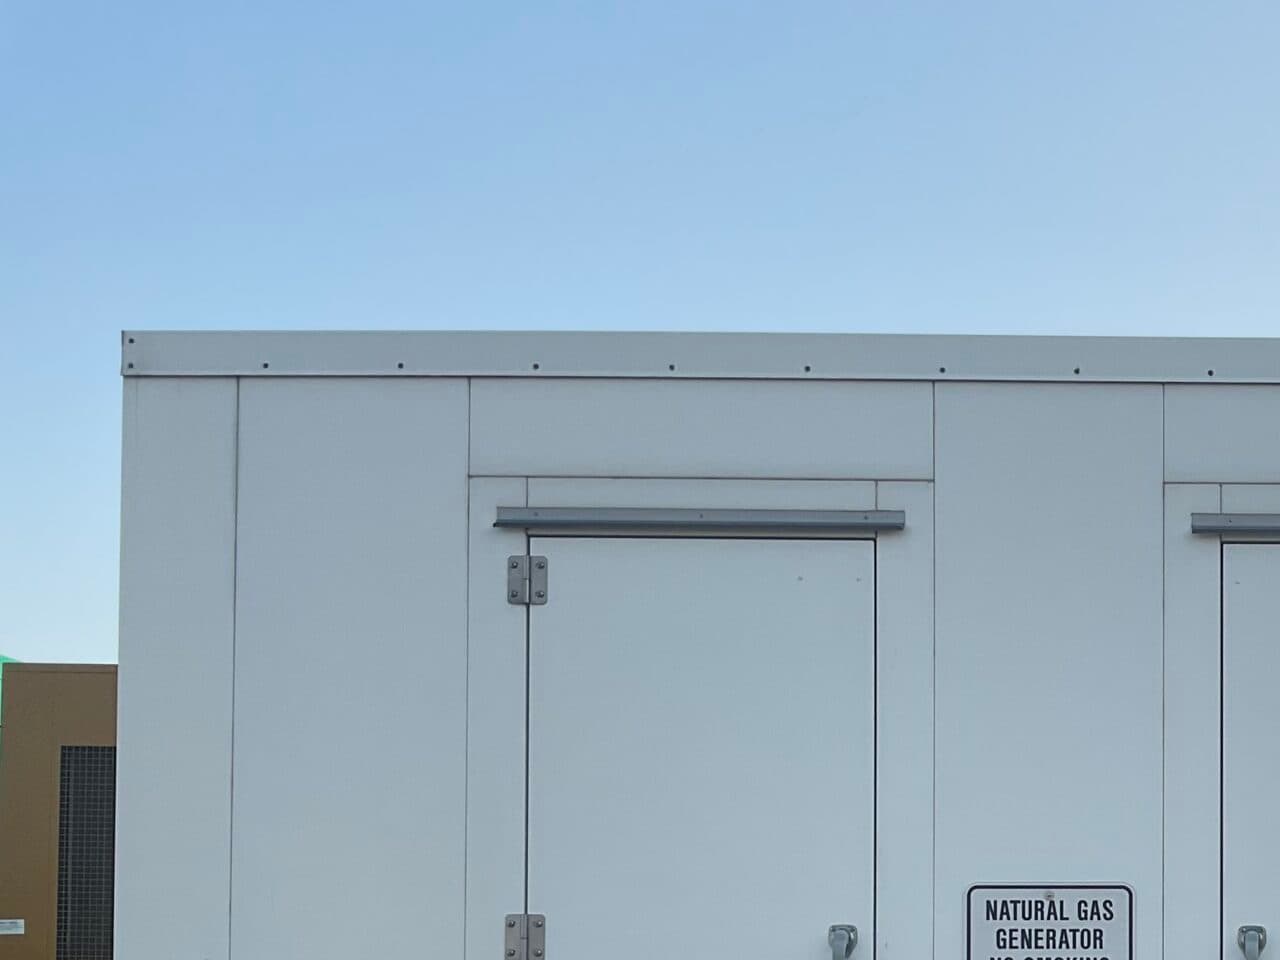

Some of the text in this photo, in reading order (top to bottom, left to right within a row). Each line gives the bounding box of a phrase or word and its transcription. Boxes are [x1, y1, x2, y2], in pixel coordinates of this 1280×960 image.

[985, 899, 1114, 921] NATURAL GAS
[995, 928, 1104, 950] GENERATOR
